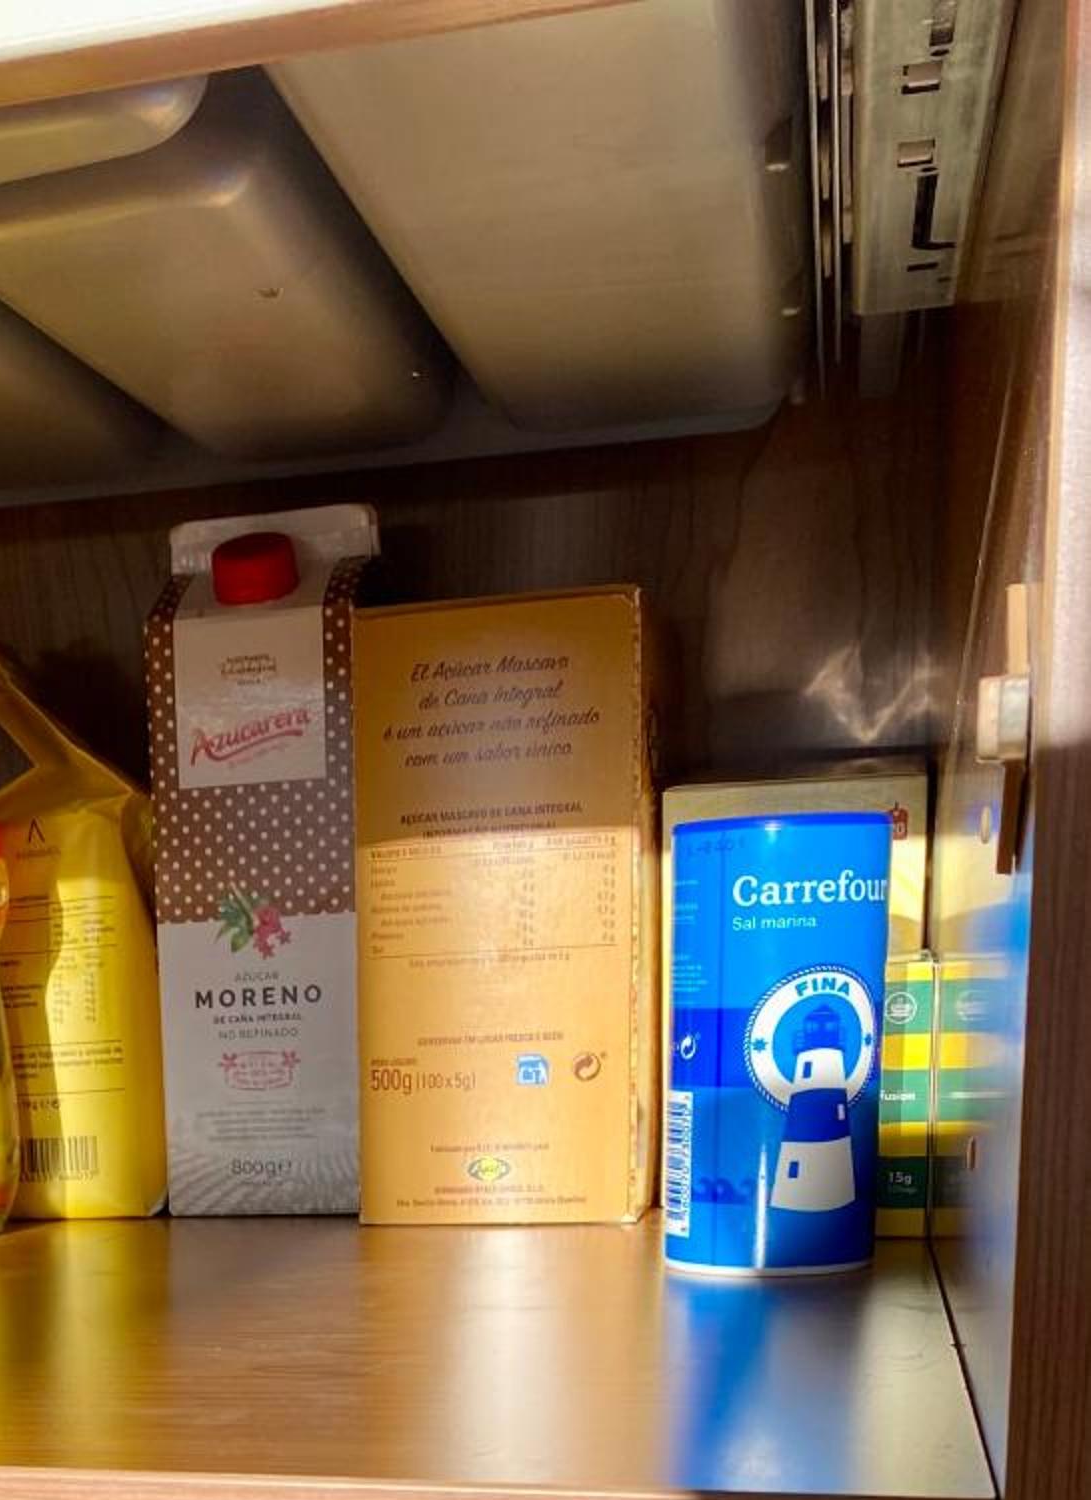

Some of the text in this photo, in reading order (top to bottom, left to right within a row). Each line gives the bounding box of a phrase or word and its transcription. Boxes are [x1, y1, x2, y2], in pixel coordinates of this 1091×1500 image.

[493, 680, 564, 708] integral
[527, 707, 600, 734] refinado
[189, 707, 311, 767] Azucarera
[733, 869, 887, 907] Carrefour
[733, 915, 817, 931] Sal marina
[195, 984, 321, 1008] MORENO
[794, 976, 851, 997] FINA
[239, 1027, 299, 1039] REFINADO
[371, 1068, 412, 1094] 500g
[889, 1171, 912, 1185] 15g
